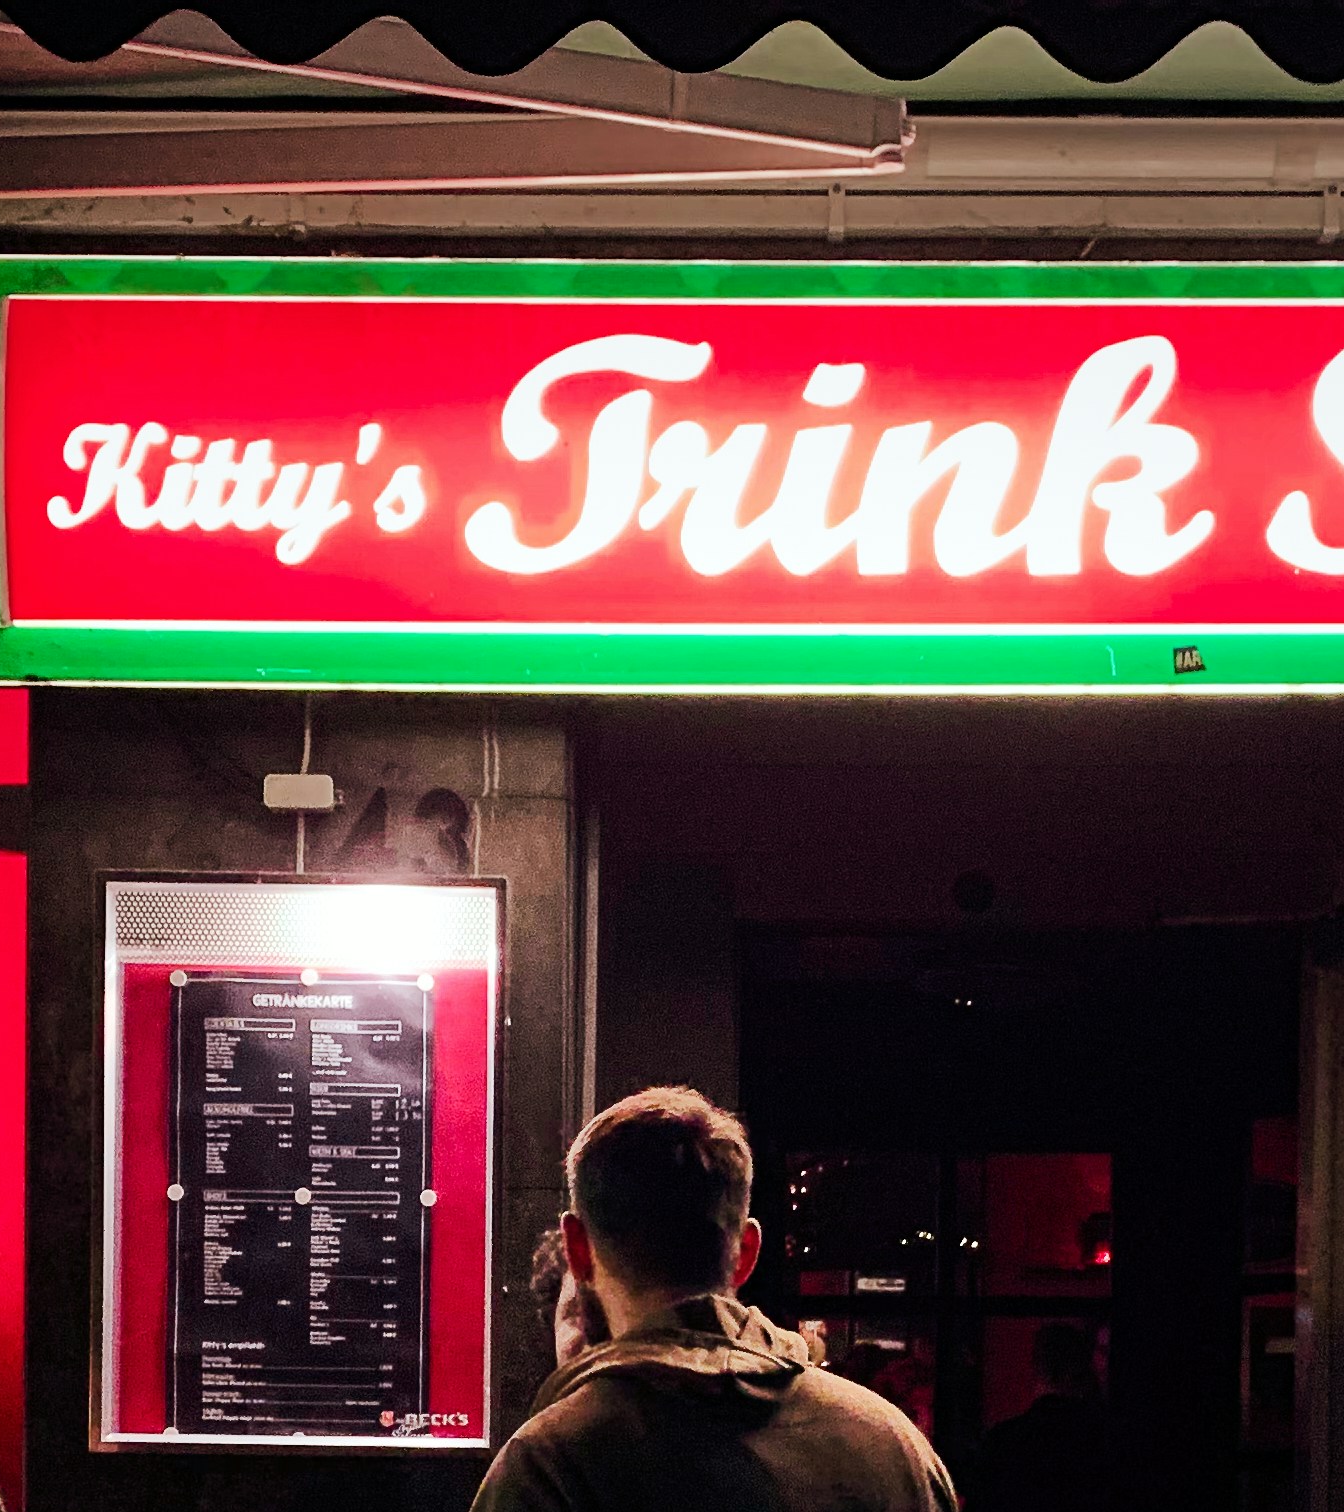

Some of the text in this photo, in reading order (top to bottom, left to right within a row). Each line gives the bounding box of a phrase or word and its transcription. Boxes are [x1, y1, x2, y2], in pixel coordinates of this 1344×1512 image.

[46, 422, 427, 566] Kitty's
[464, 333, 1215, 576] Trink
[253, 993, 354, 1010] GETRÄNKEKARTE
[405, 1411, 469, 1426] BECK'S
